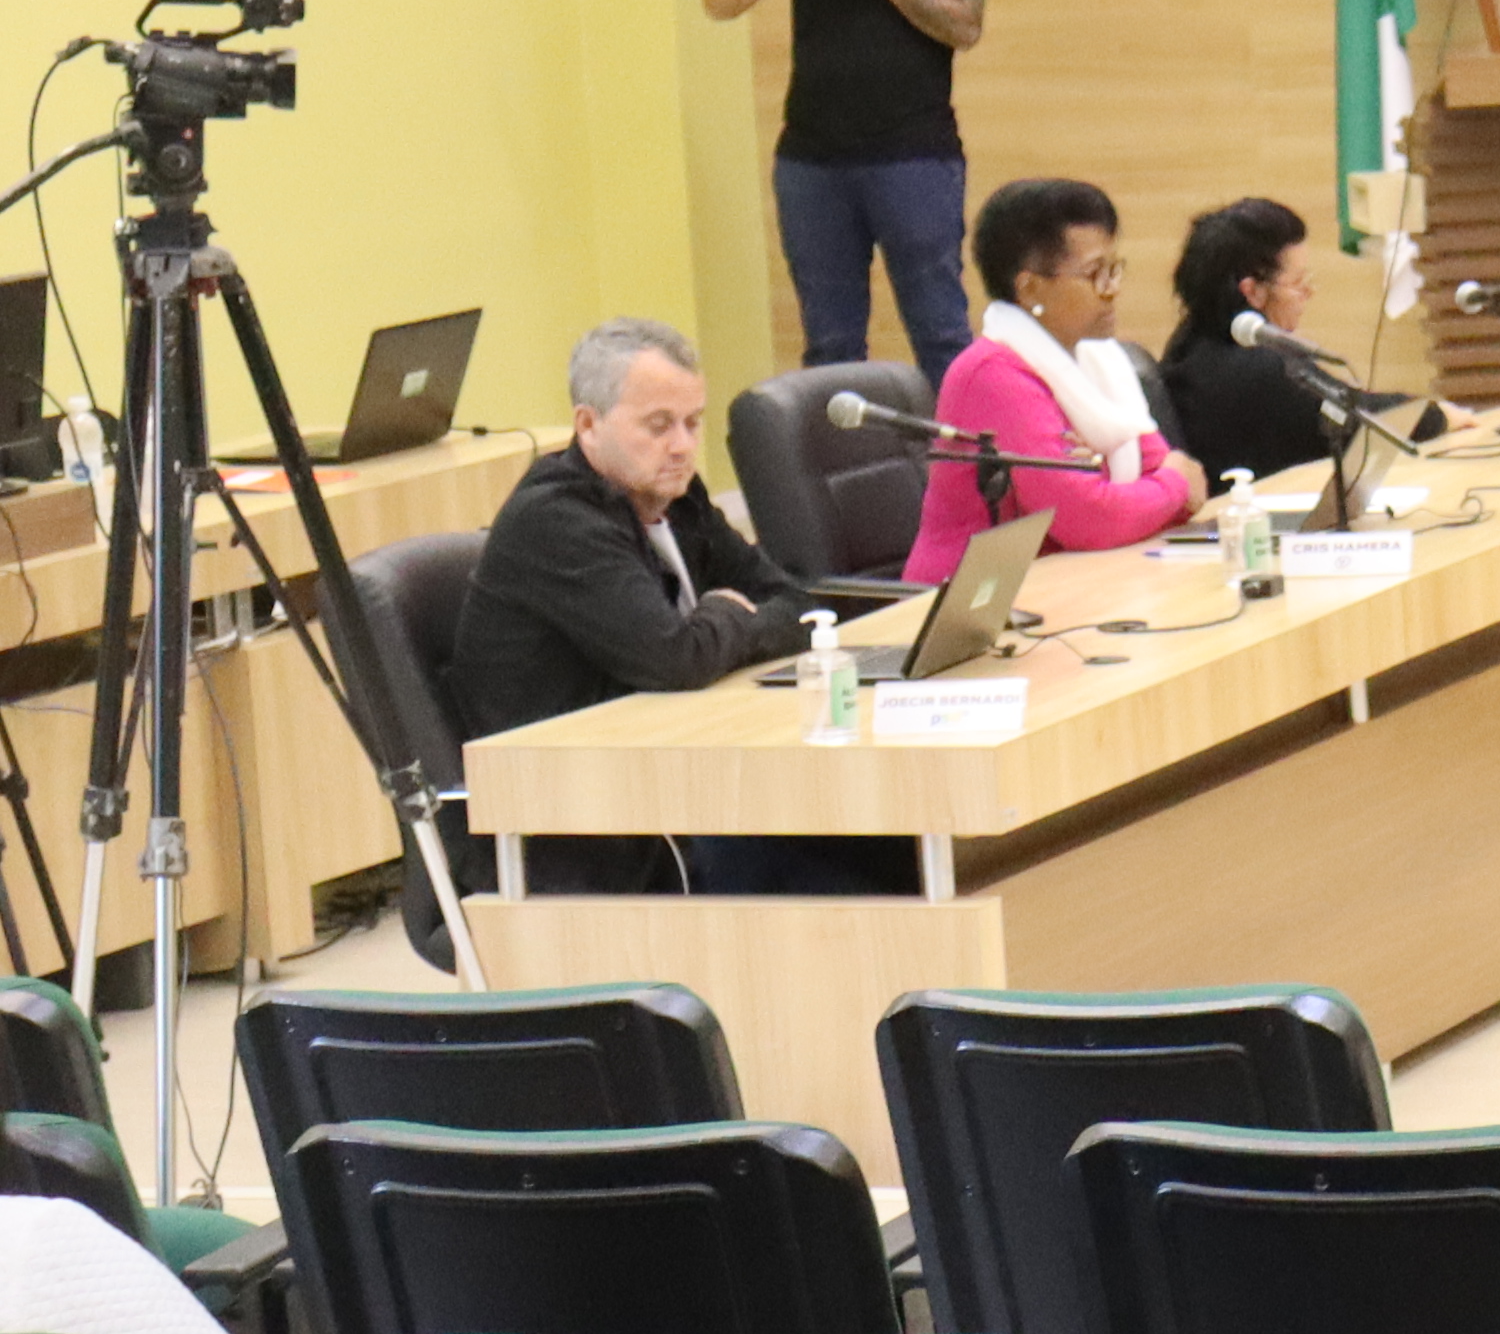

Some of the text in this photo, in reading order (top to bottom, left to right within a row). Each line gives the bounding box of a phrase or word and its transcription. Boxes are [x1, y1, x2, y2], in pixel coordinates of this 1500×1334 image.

[1292, 540, 1402, 555] CRIS HAMERA
[878, 693, 1020, 709] JOECIR BERNARDI
